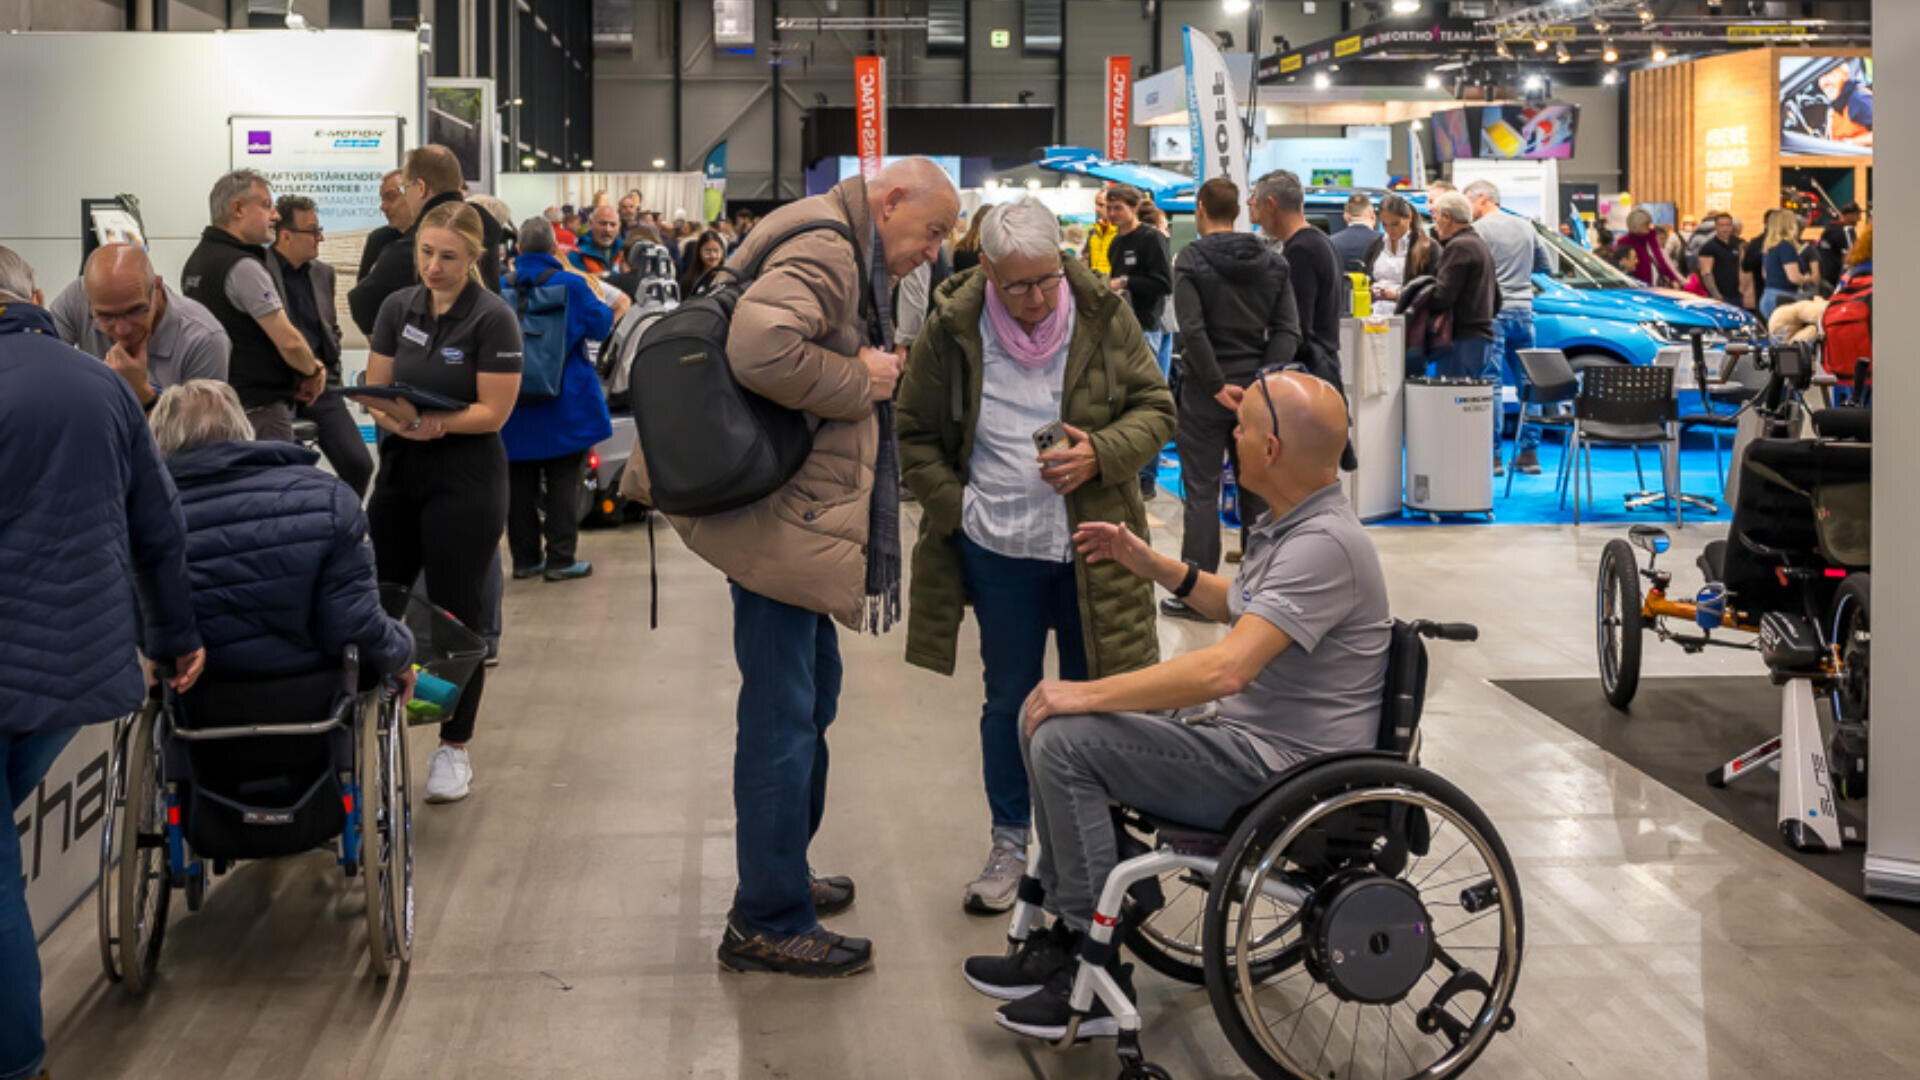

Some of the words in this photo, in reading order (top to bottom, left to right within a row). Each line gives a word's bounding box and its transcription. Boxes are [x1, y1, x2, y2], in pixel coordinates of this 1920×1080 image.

[1391, 31, 1432, 41] ORTHO
[1439, 31, 1473, 41] TEAM
[272, 184, 361, 193] ZUSATZANTRIEB
[1705, 170, 1734, 189] FREI
[1705, 191, 1734, 211] HEIT
[17, 750, 109, 881] ha
